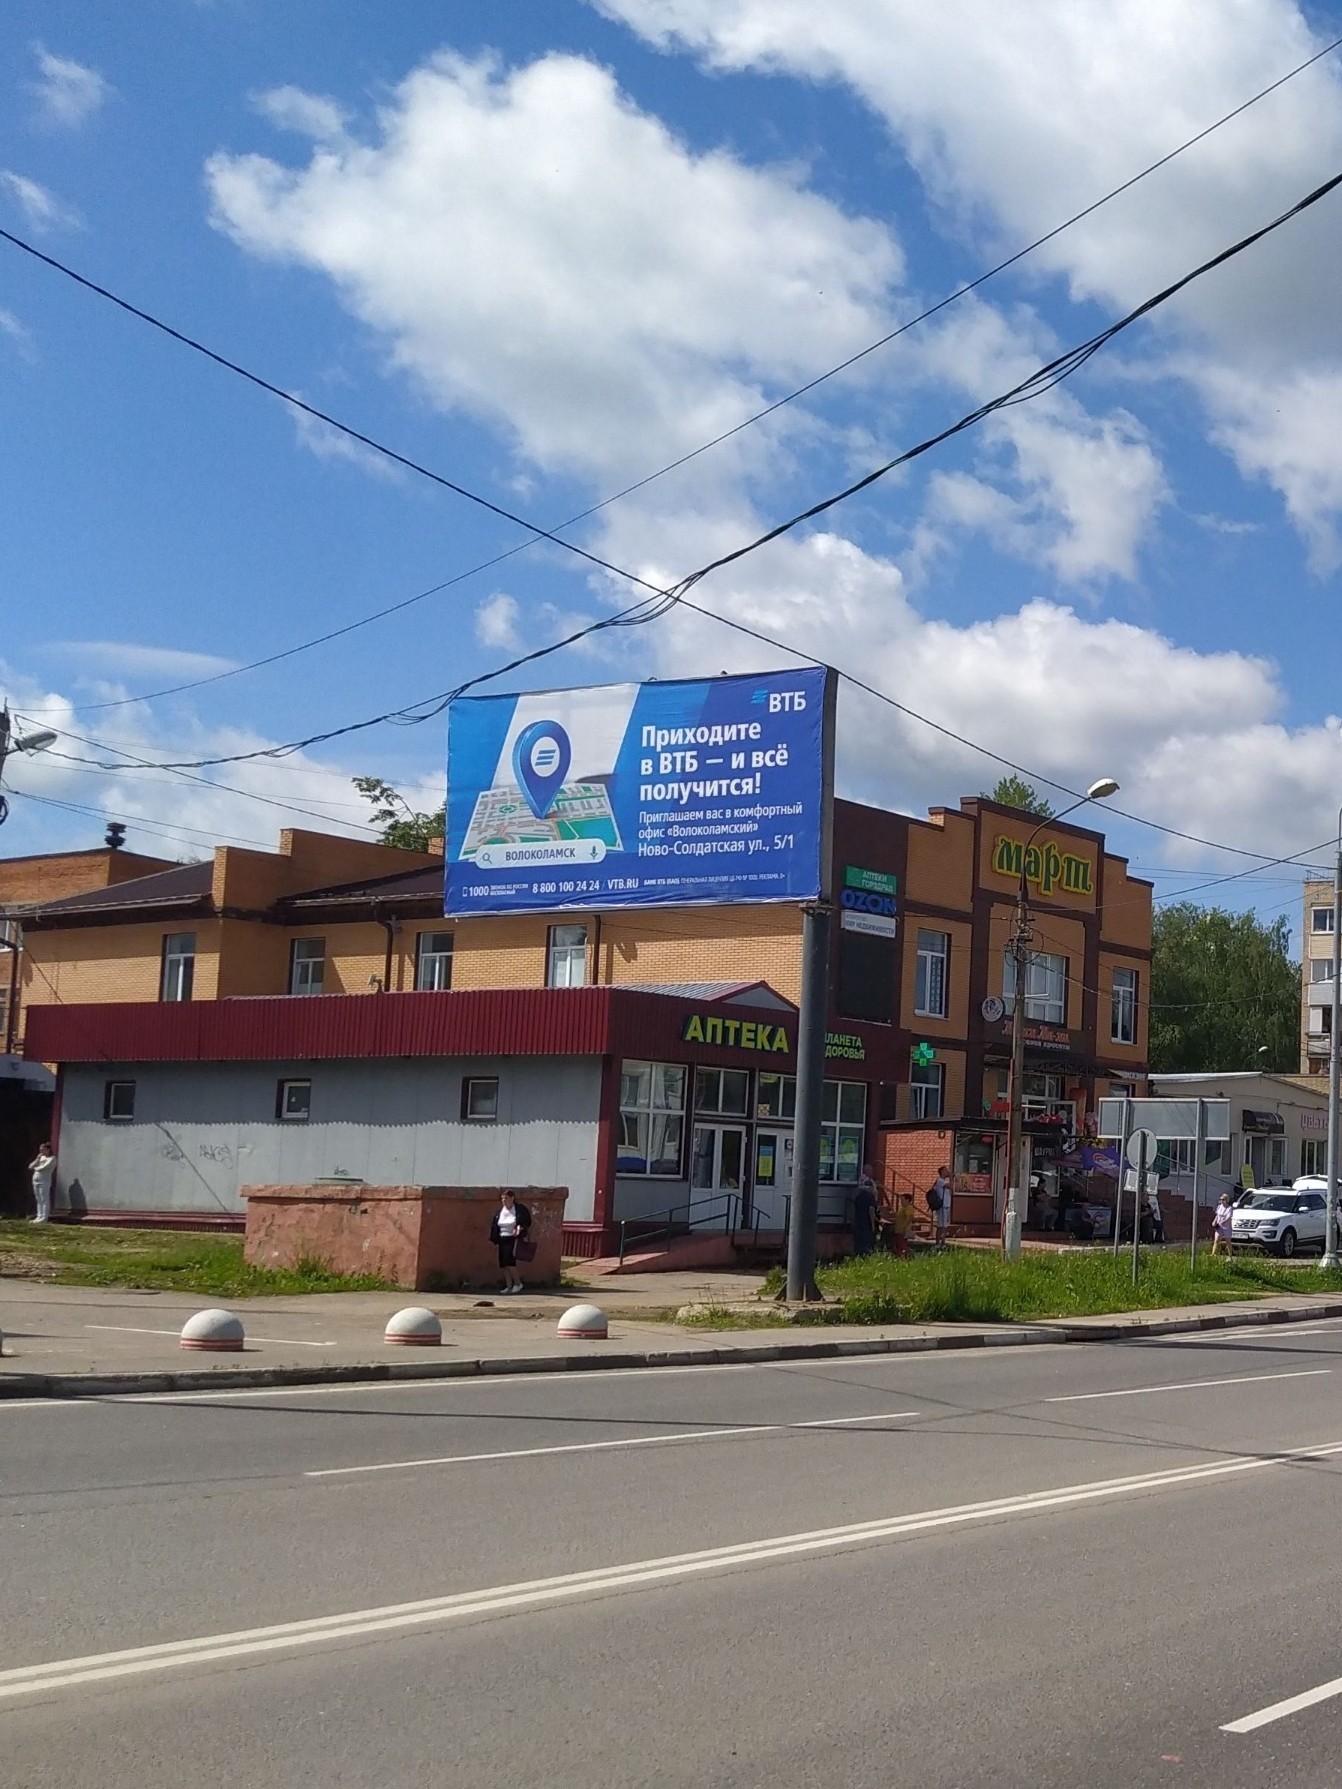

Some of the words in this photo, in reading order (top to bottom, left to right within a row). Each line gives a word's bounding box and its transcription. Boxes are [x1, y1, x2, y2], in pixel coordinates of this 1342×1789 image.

[769, 691, 806, 712] ВТБ
[642, 722, 762, 752] Приходите
[640, 758, 653, 775] в
[660, 751, 698, 774] ВТБ
[731, 752, 745, 770] и
[752, 744, 788, 768] всё
[640, 772, 761, 805] получится!
[639, 809, 704, 825] Приглашаем
[706, 808, 723, 820] вас
[725, 808, 732, 818] в
[734, 802, 802, 819] комфортный
[638, 826, 666, 840] офис
[667, 821, 758, 837] «Волоколамский»
[506, 848, 576, 861] ВОЛОКОЛАМСК
[638, 839, 744, 857] Ново-Солдатская
[748, 838, 770, 855] ул.,
[774, 834, 794, 850] 5/1
[532, 883, 538, 894] 8
[540, 882, 556, 893] 800
[559, 881, 574, 892] 100
[576, 881, 587, 892] 24
[589, 880, 600, 891] 24
[608, 878, 639, 890] VTB.RU
[862, 871, 887, 882] АПТЕКИ
[469, 886, 490, 897] 1000
[840, 889, 896, 915] OZON
[685, 1015, 789, 1053] АПТЕКА
[825, 1045, 866, 1060] ДОРОВЬЯ
